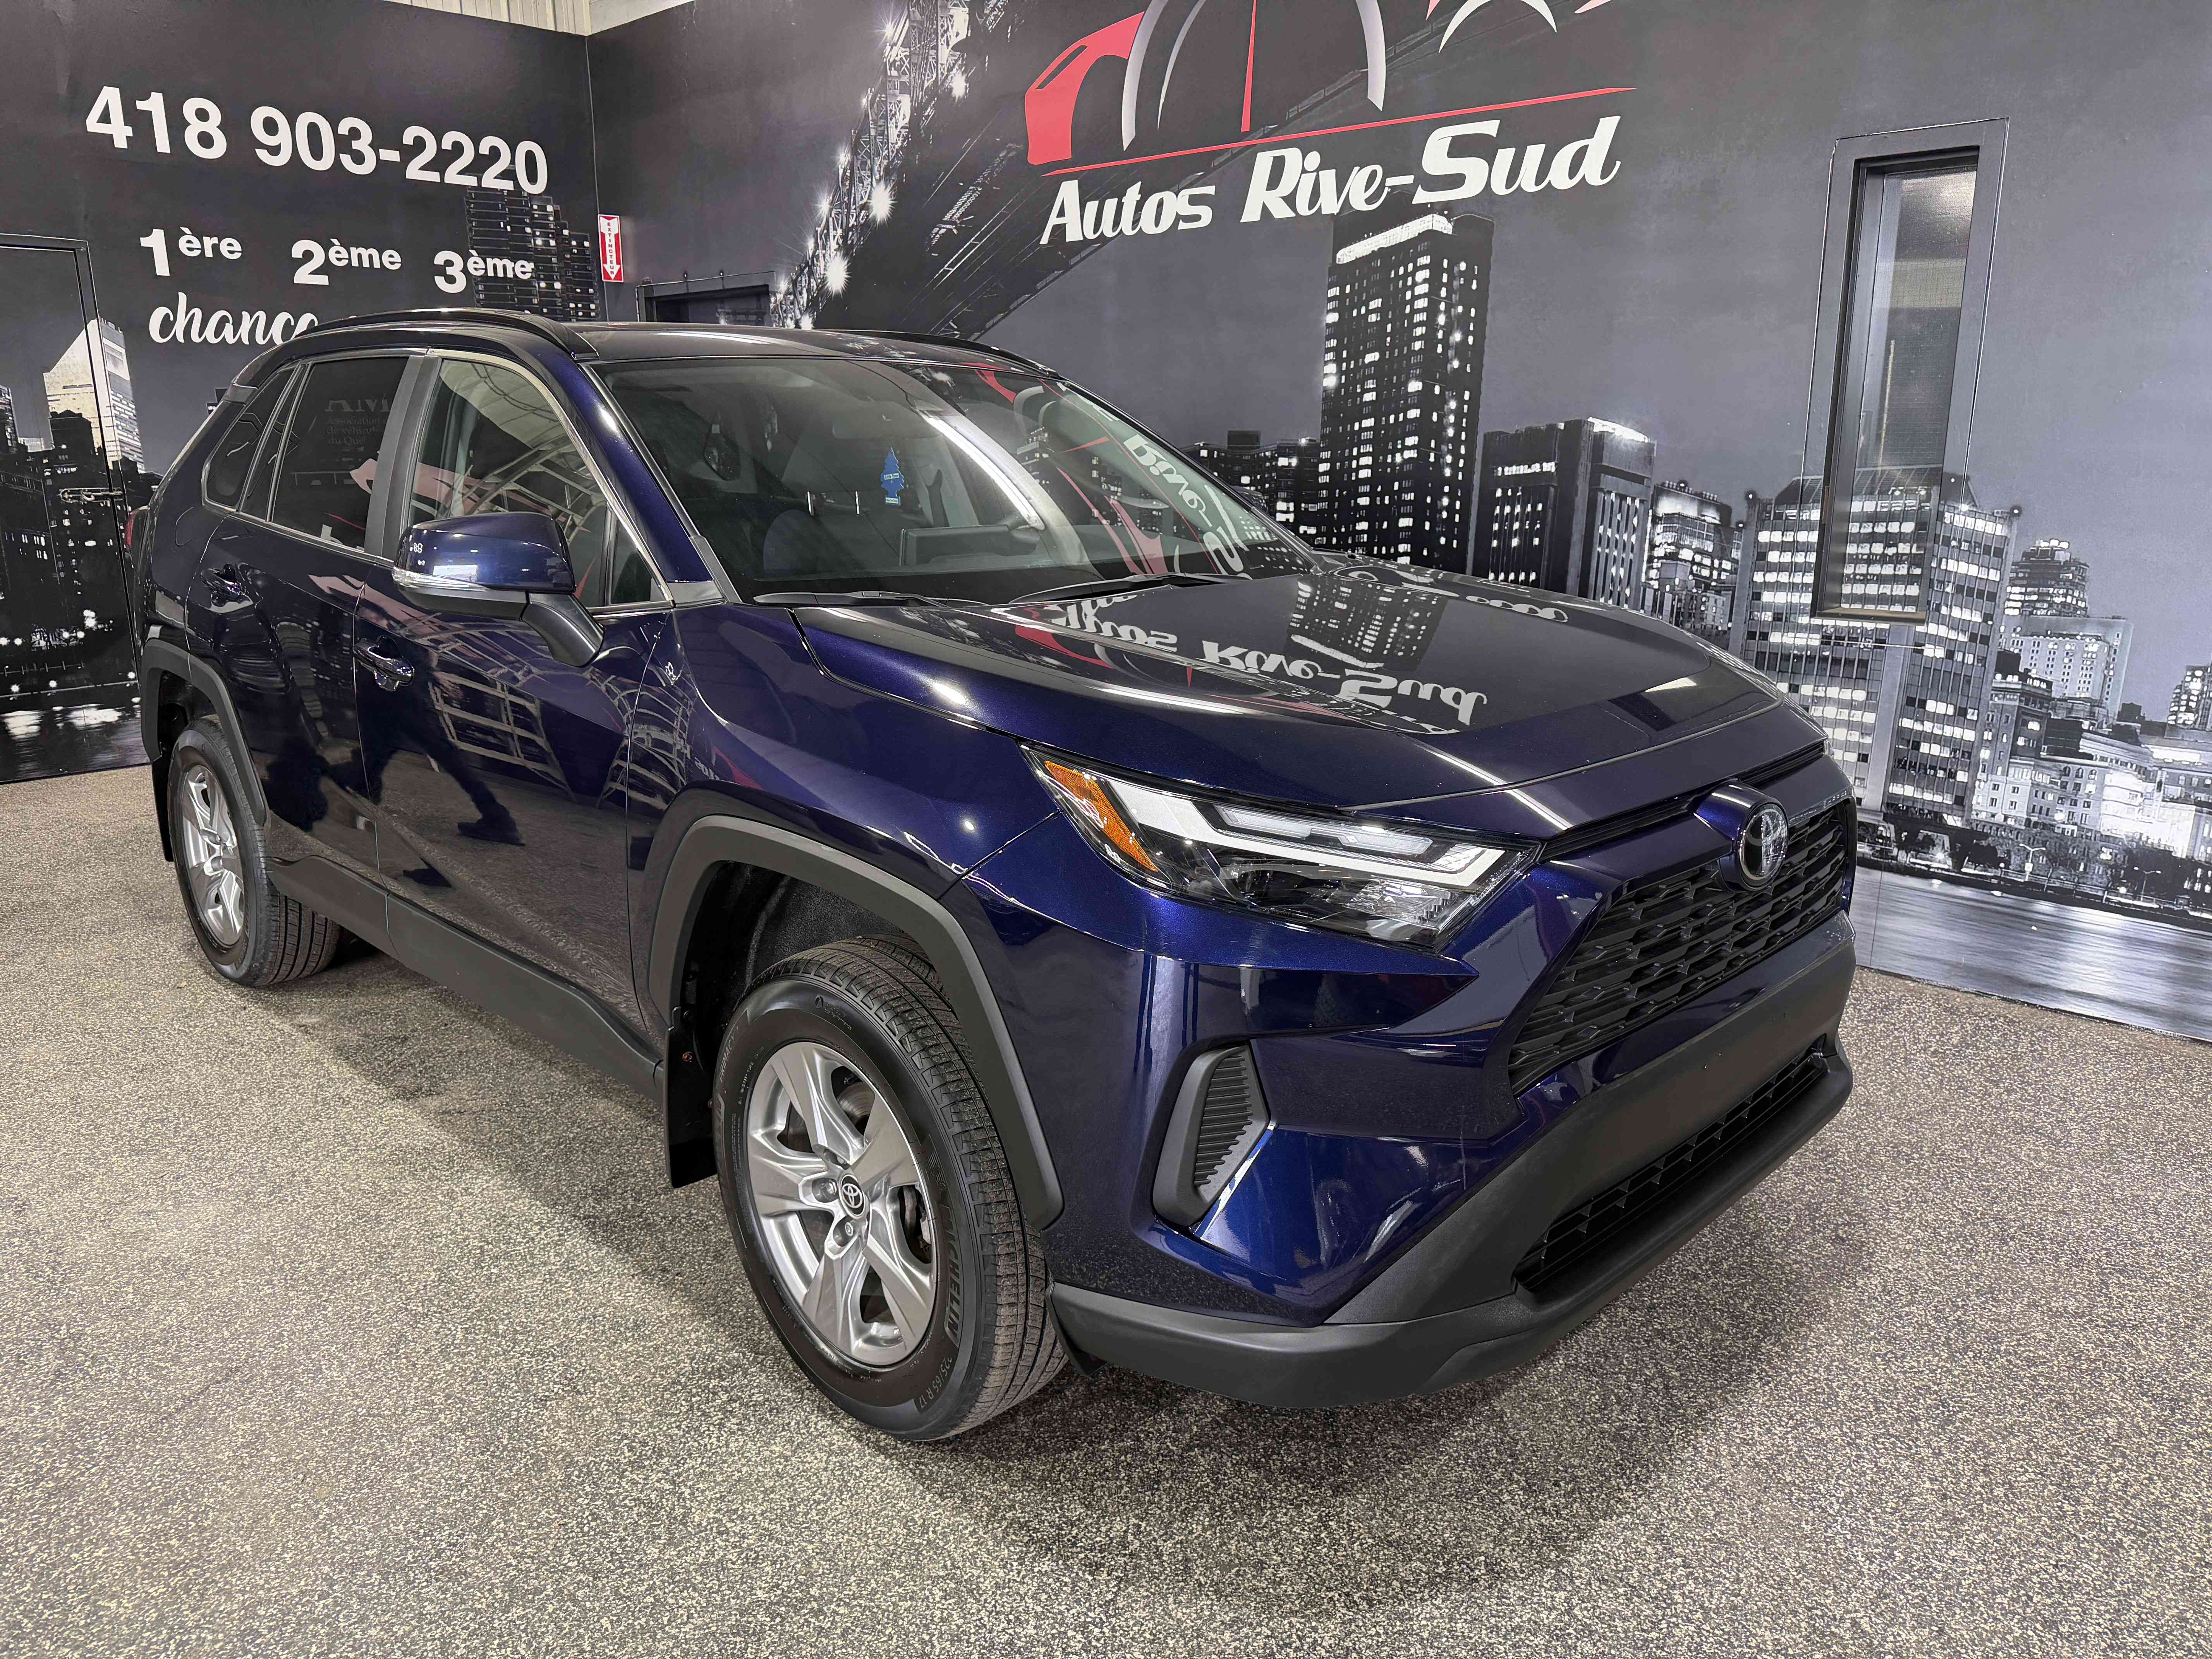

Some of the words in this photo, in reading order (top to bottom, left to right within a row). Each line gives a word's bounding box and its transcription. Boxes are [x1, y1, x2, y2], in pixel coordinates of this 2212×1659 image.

[86, 86, 227, 159] 418
[251, 106, 547, 194] 903-2220
[1040, 180, 1215, 244] Autos
[1240, 116, 1621, 222] Rive-Sud
[940, 1204, 960, 1338] MICHELIN
